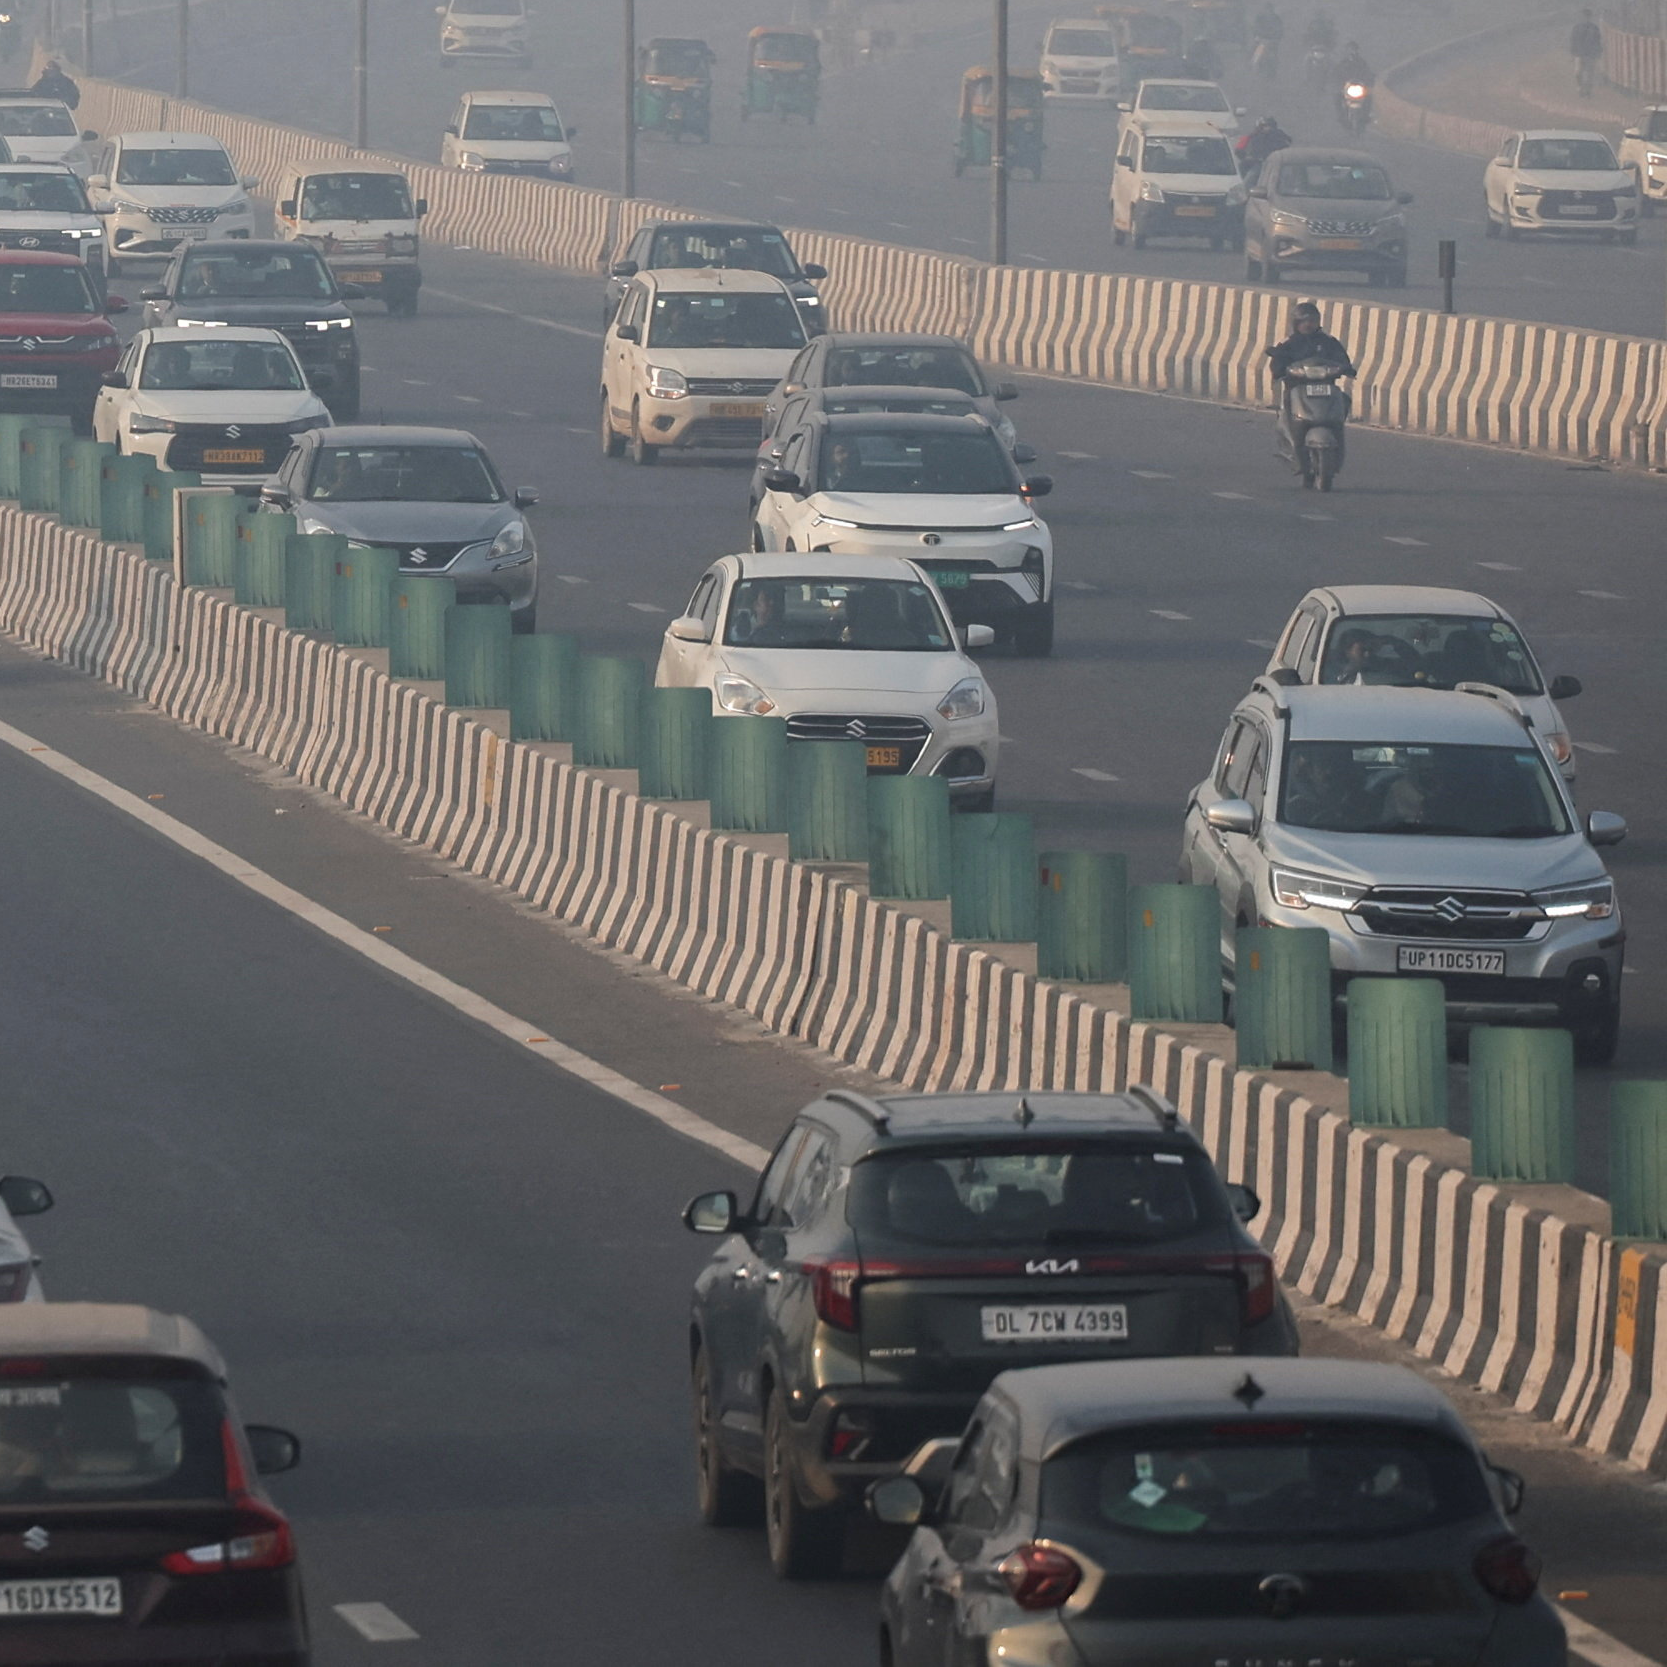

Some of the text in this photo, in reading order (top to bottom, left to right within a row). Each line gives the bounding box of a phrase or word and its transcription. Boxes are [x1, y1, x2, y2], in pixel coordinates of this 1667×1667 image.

[868, 750, 898, 764] 5195
[1409, 951, 1501, 970] UP11DC5177
[1025, 1259, 1080, 1274] KIA
[1074, 1311, 1124, 1331] 4399
